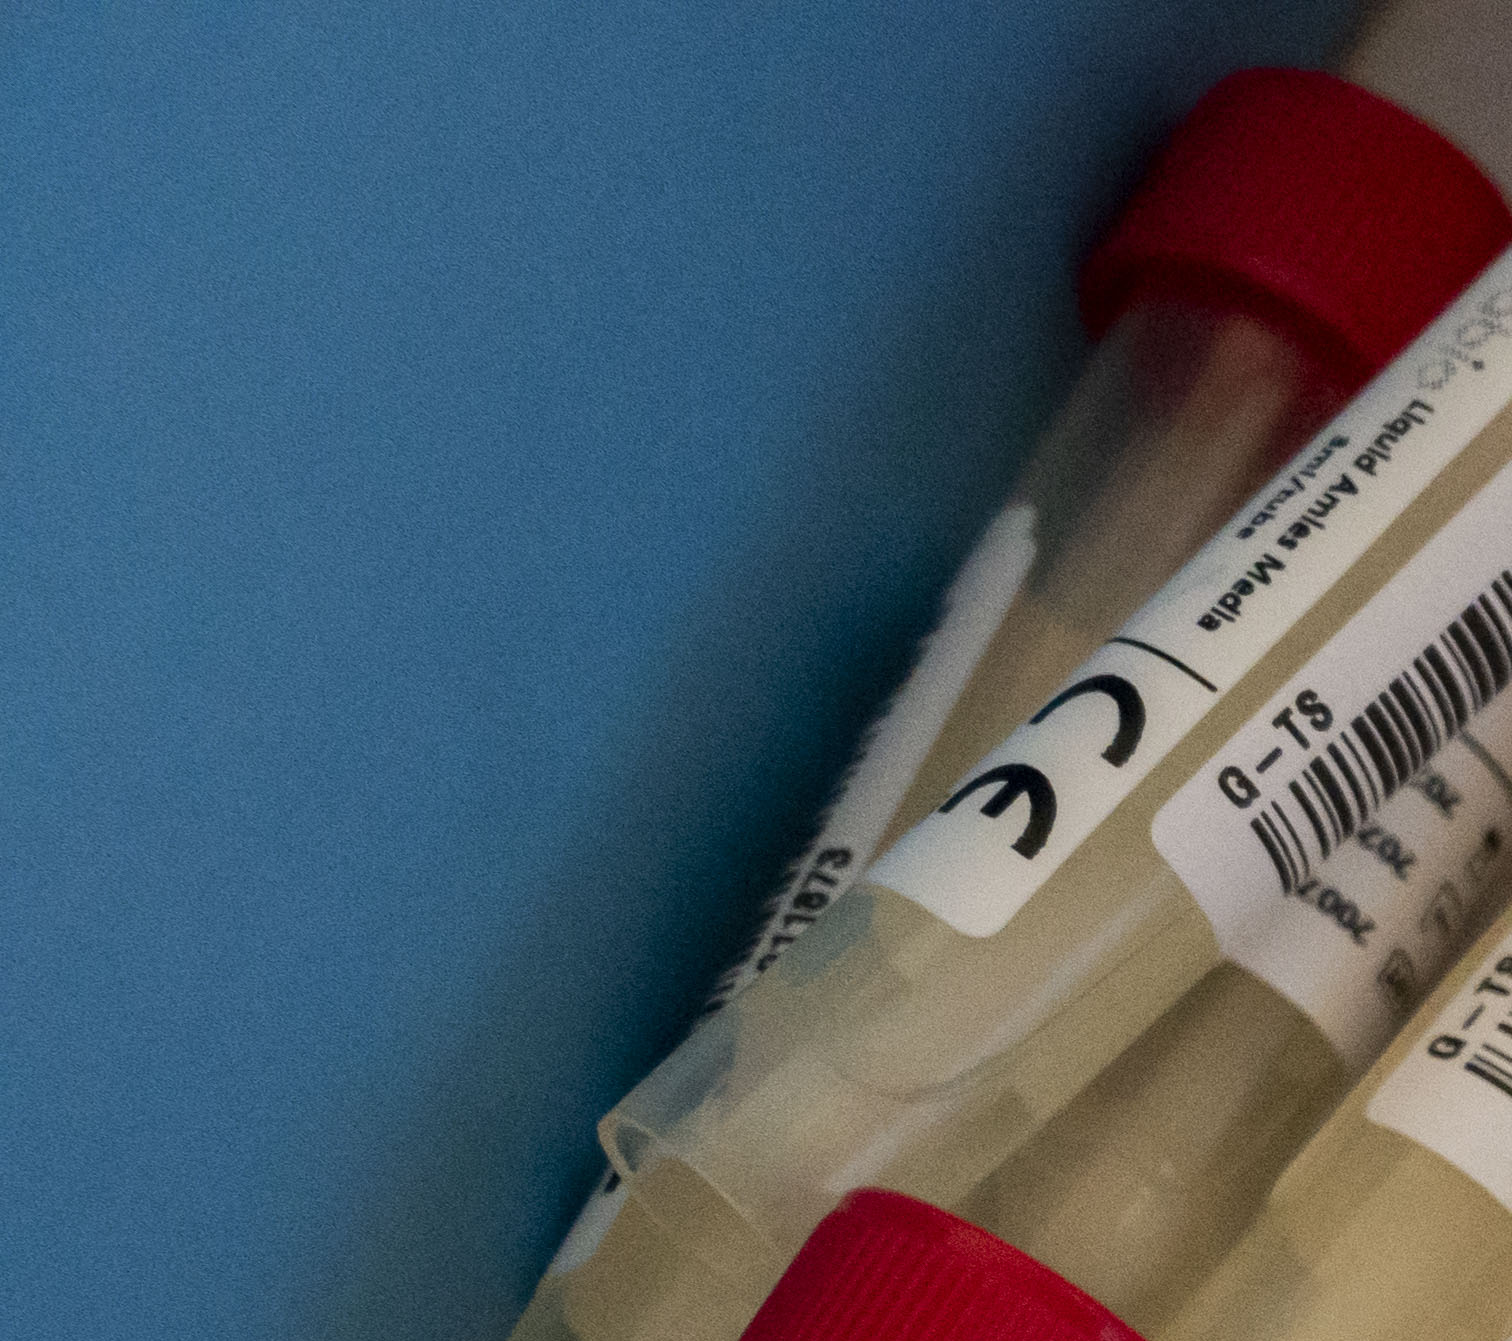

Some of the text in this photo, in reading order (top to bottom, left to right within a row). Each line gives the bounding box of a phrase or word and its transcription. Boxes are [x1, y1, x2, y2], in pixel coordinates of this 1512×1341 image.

[1352, 398, 1434, 477] Liquid
[1276, 472, 1359, 551] Amies
[1196, 552, 1286, 633] Media
[1216, 688, 1334, 810] G-TS
